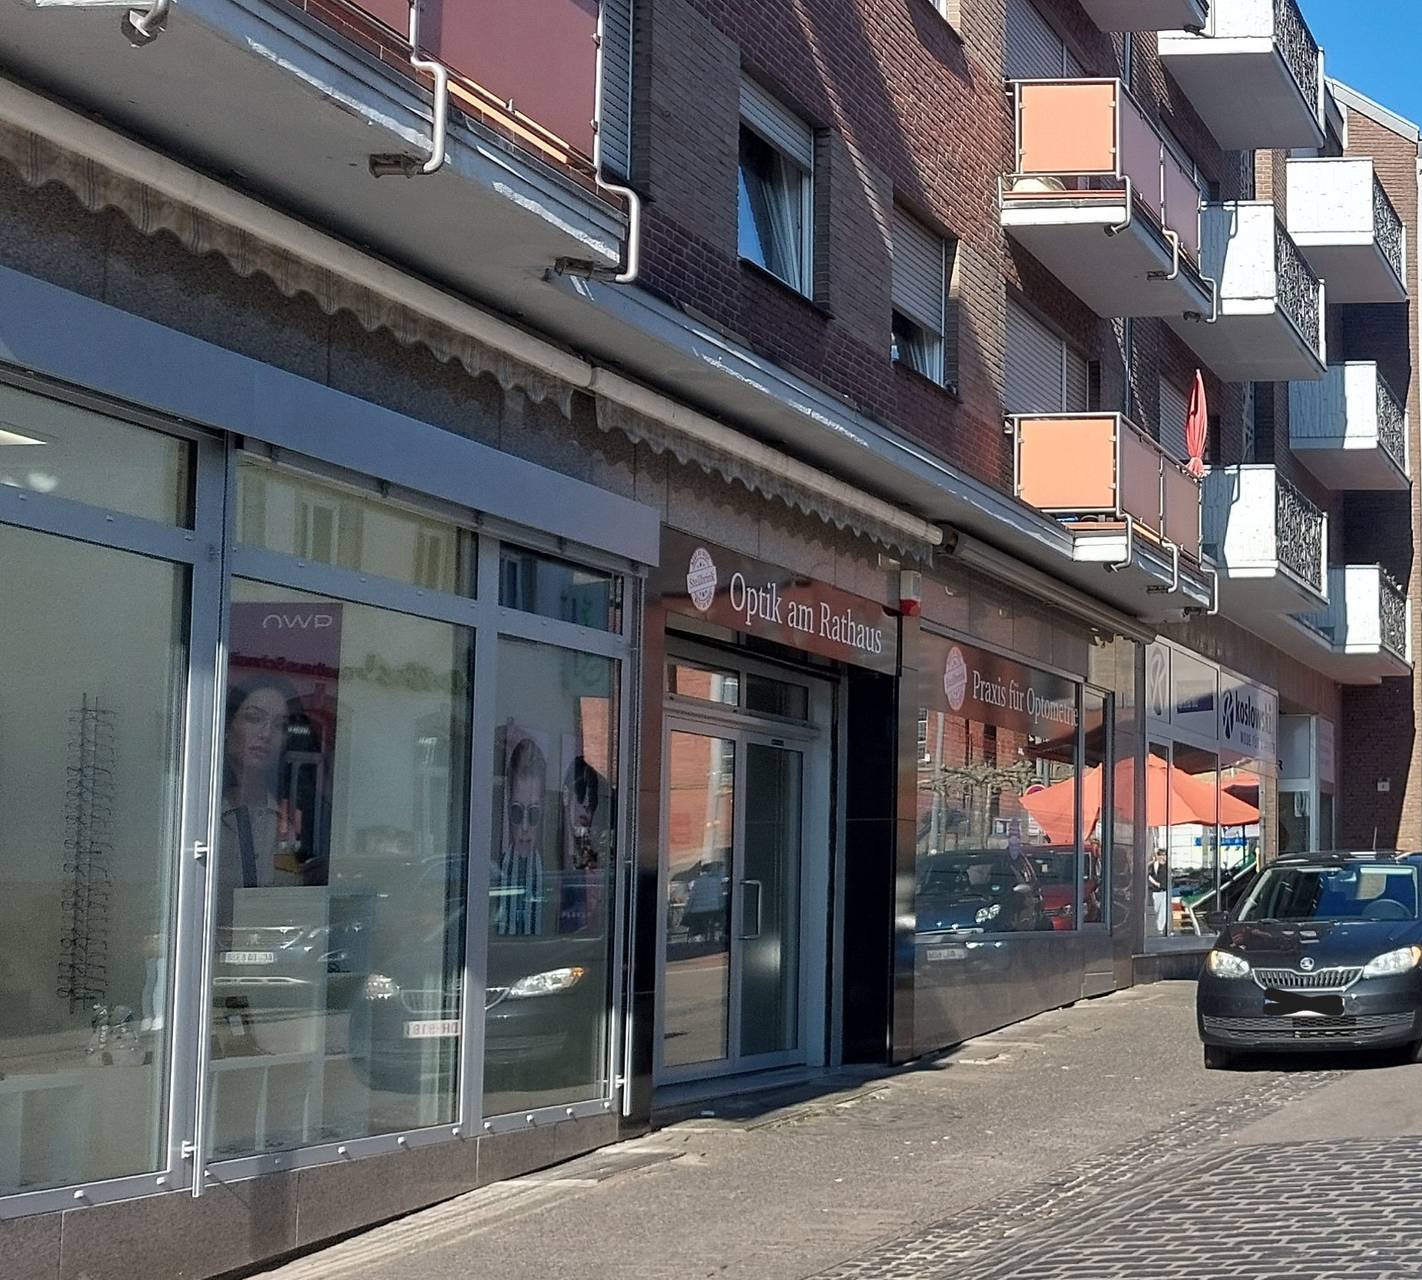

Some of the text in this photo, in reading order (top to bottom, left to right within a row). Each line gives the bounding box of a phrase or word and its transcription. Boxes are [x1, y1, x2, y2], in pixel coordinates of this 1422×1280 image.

[730, 572, 782, 625] Optik
[788, 601, 815, 634] am
[819, 602, 882, 654] Rathaus
[972, 670, 1007, 707] Praxis
[1009, 680, 1025, 712] für
